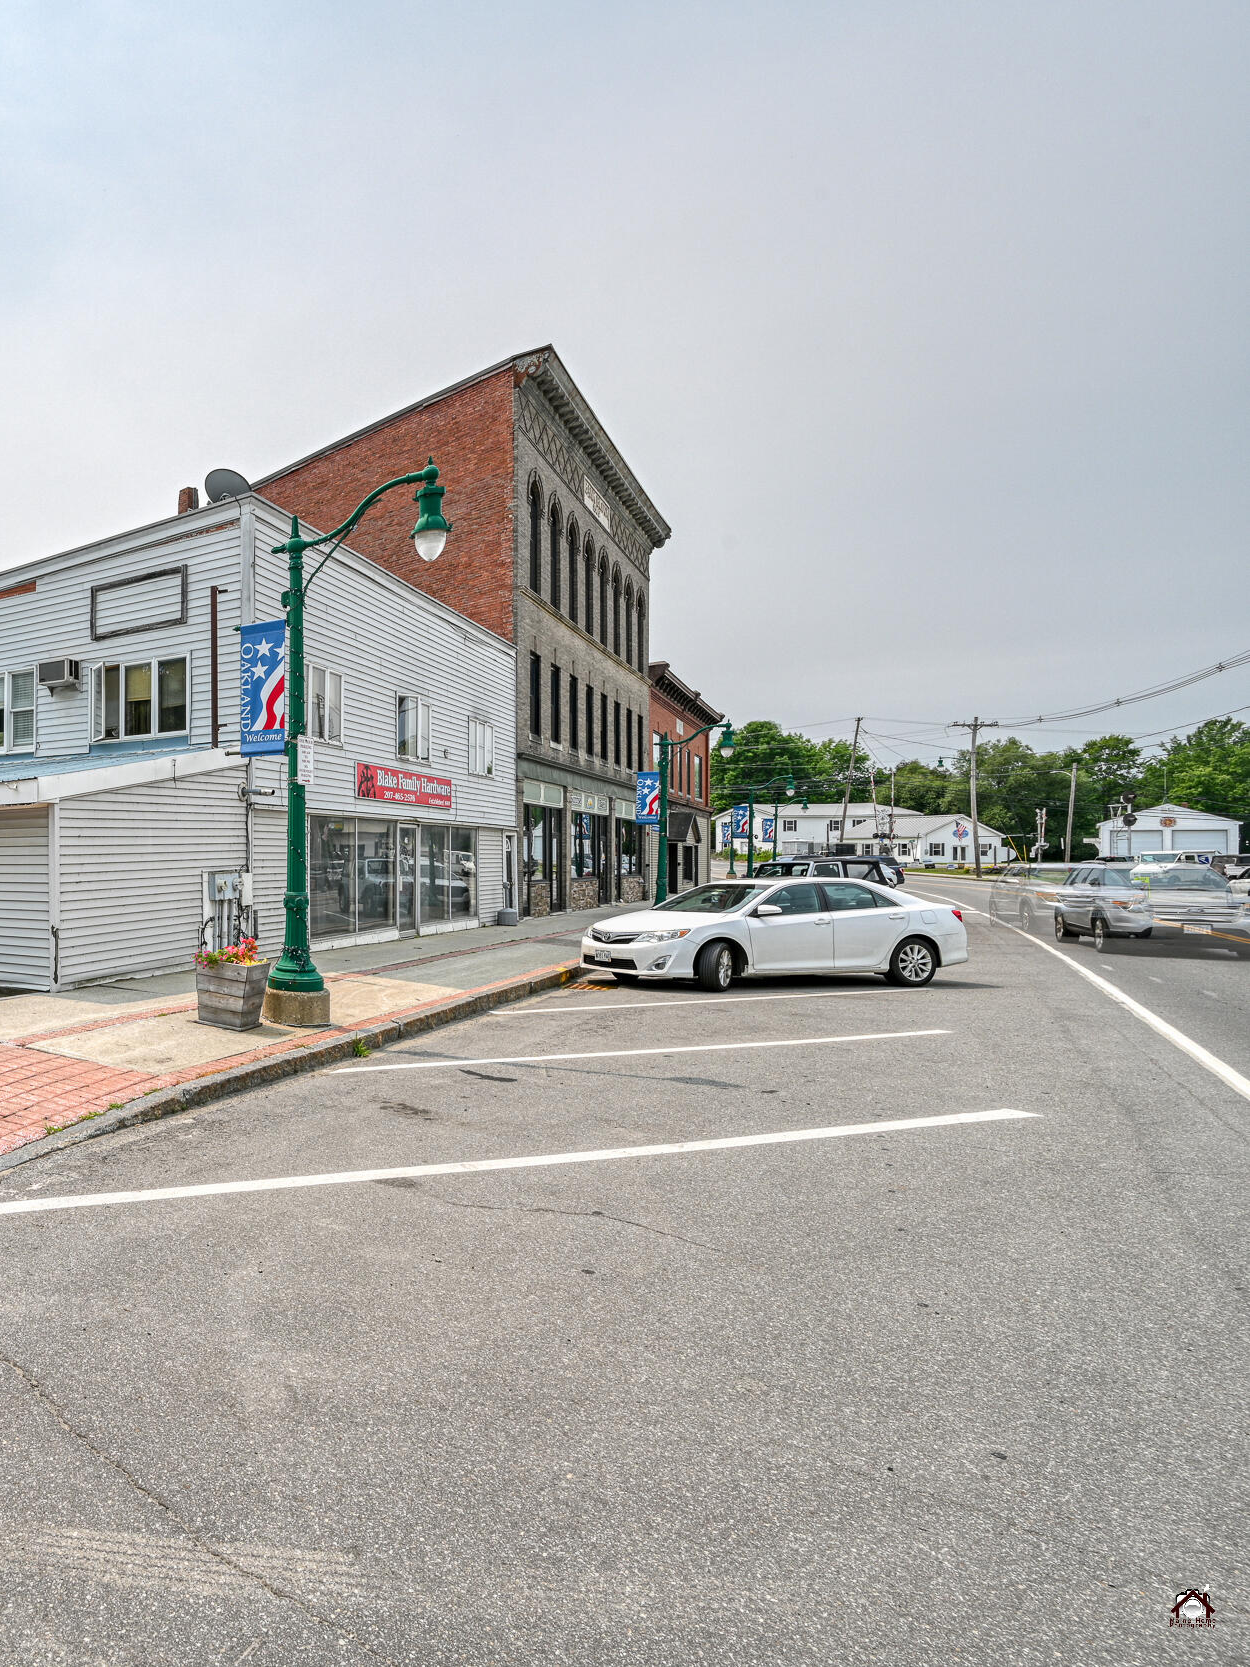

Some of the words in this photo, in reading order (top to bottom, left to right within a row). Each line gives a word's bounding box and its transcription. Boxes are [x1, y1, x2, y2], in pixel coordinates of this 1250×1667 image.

[241, 643, 254, 732] OAKLAND
[244, 731, 282, 743] Welcome
[376, 769, 398, 789] Blake
[398, 773, 421, 796] Family
[421, 777, 451, 796] Hardware
[636, 779, 644, 815] OAKLAND
